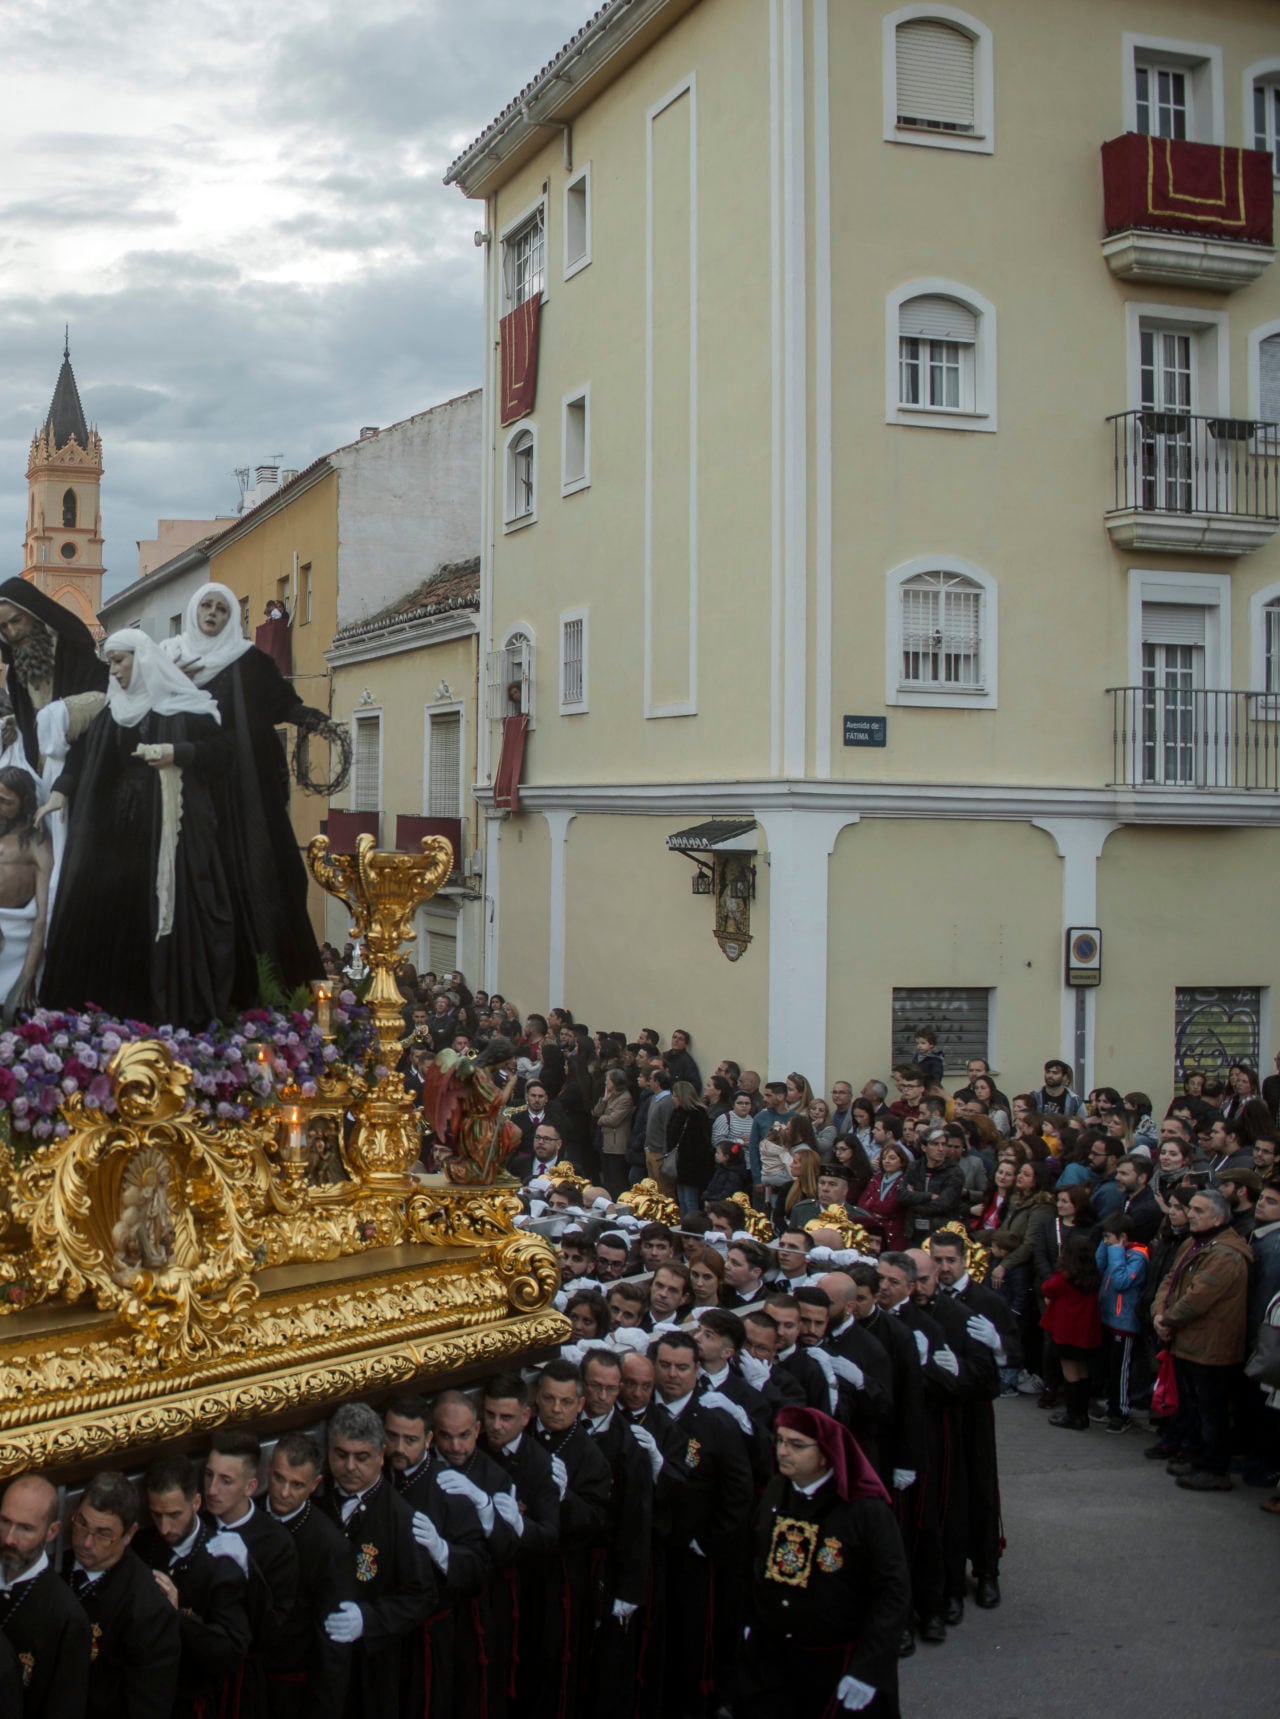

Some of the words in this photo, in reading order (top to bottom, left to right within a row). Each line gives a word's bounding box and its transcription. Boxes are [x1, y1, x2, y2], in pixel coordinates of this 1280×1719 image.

[846, 721, 870, 729] Avenida
[871, 722, 879, 730] de
[846, 731, 869, 740] FÁTIMA
